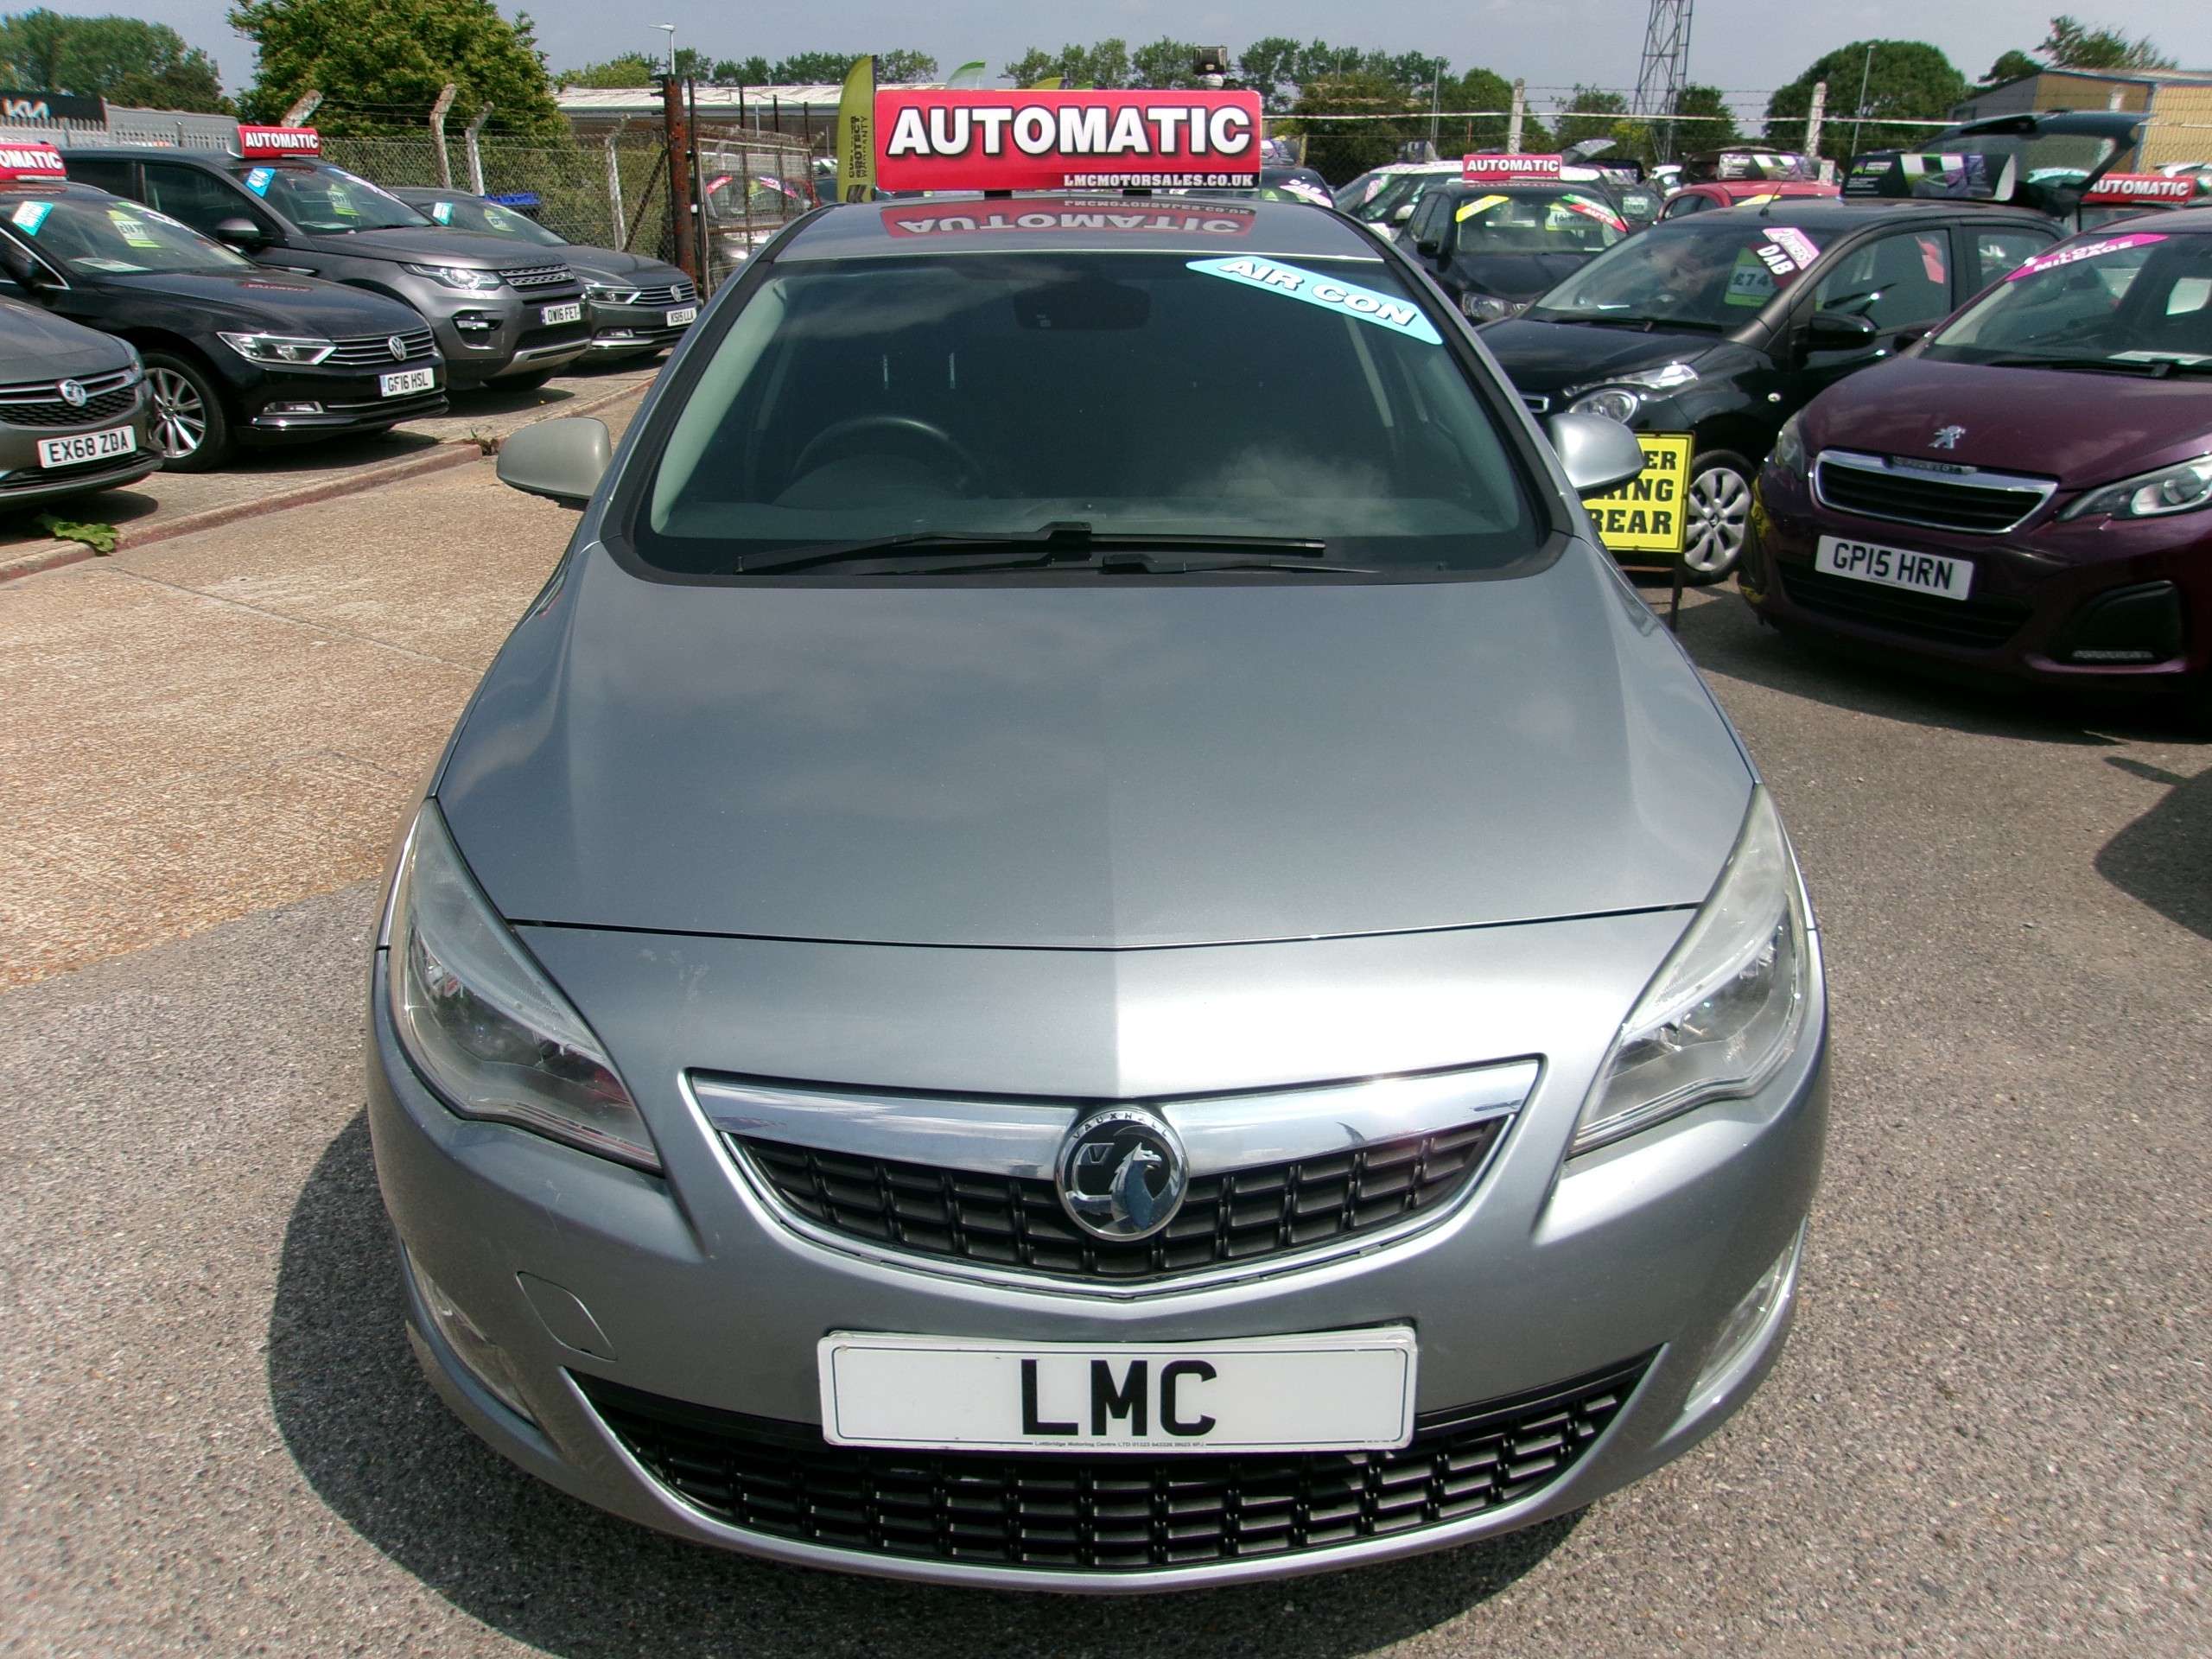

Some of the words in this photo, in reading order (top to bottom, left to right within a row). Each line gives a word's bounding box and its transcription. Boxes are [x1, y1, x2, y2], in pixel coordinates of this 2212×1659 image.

[245, 132, 319, 149] AUTOMATIC
[887, 105, 1251, 156] AUTOMATIC
[1466, 159, 1559, 172] AUTOMATIC
[1064, 174, 1253, 187] LMCMOTORSALES.CO.UK
[2089, 179, 2190, 196] AUTOMATIC
[1756, 244, 1796, 275] DAB
[2059, 241, 2108, 259] LOW
[1218, 259, 1305, 292] AIR
[1311, 283, 1419, 327] CON
[387, 375, 409, 391] GF16
[410, 372, 429, 389] HSL
[48, 437, 96, 462] EX68
[1591, 509, 1673, 535] REAR
[1833, 542, 1891, 578] GP15
[1897, 553, 1953, 590] HRN
[1073, 1113, 1168, 1139] VAUXHALL
[1020, 1359, 1217, 1438] LMC
